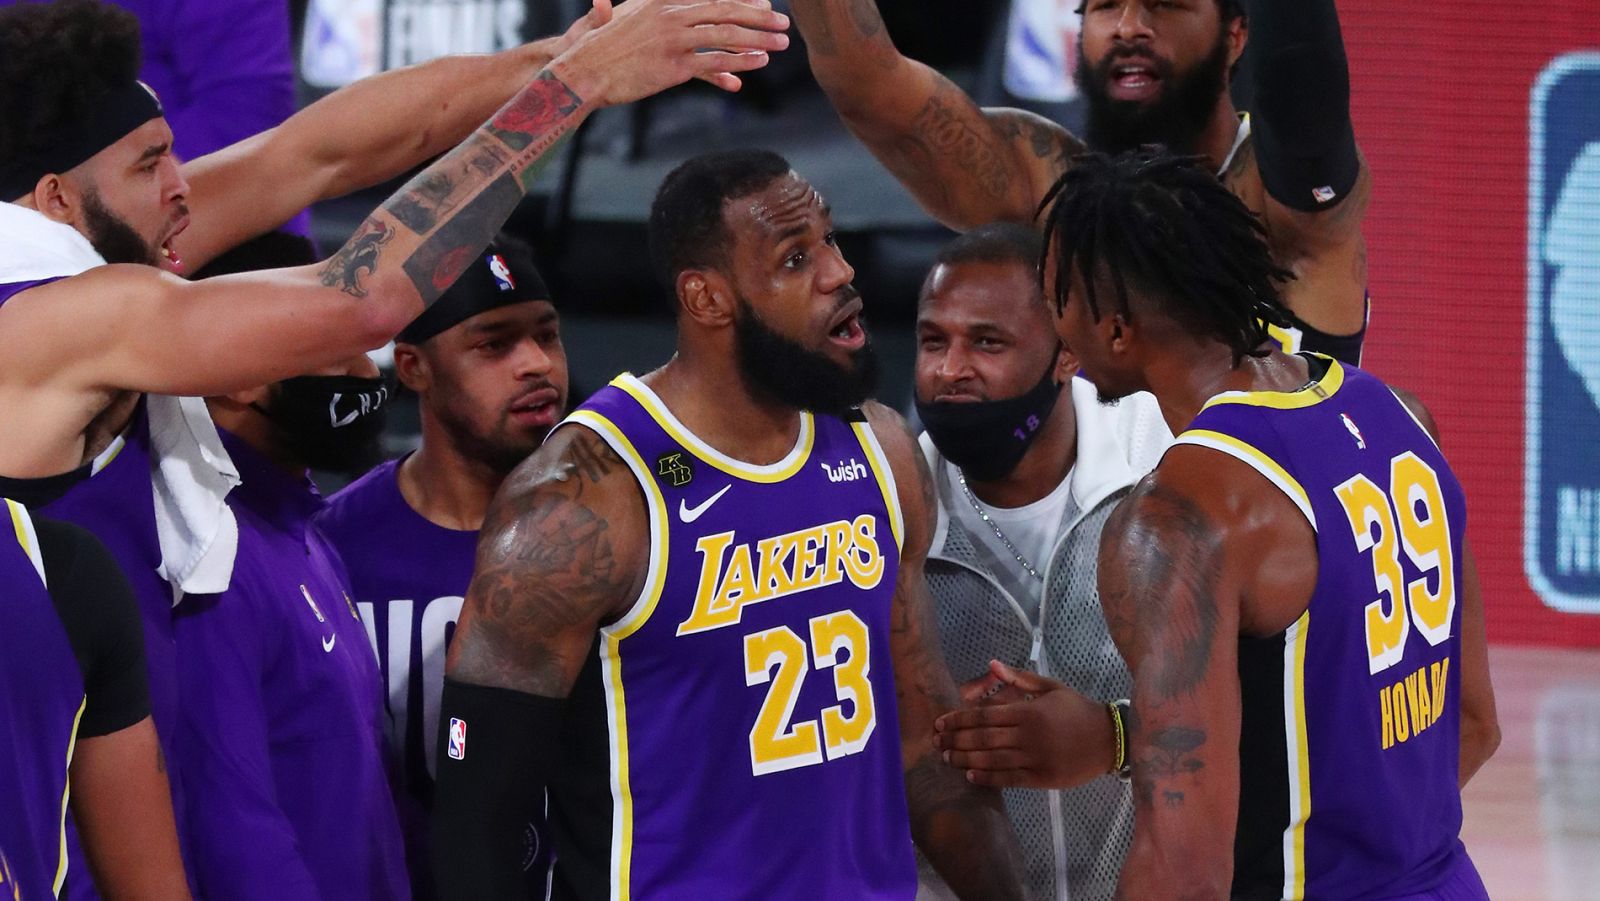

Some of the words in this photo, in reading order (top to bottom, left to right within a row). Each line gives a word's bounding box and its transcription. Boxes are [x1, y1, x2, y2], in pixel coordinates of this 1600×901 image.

[821, 458, 867, 482] wish
[1013, 415, 1040, 440] 18
[675, 514, 885, 637] LAKERS
[1333, 450, 1456, 676] 39
[743, 609, 877, 776] 23
